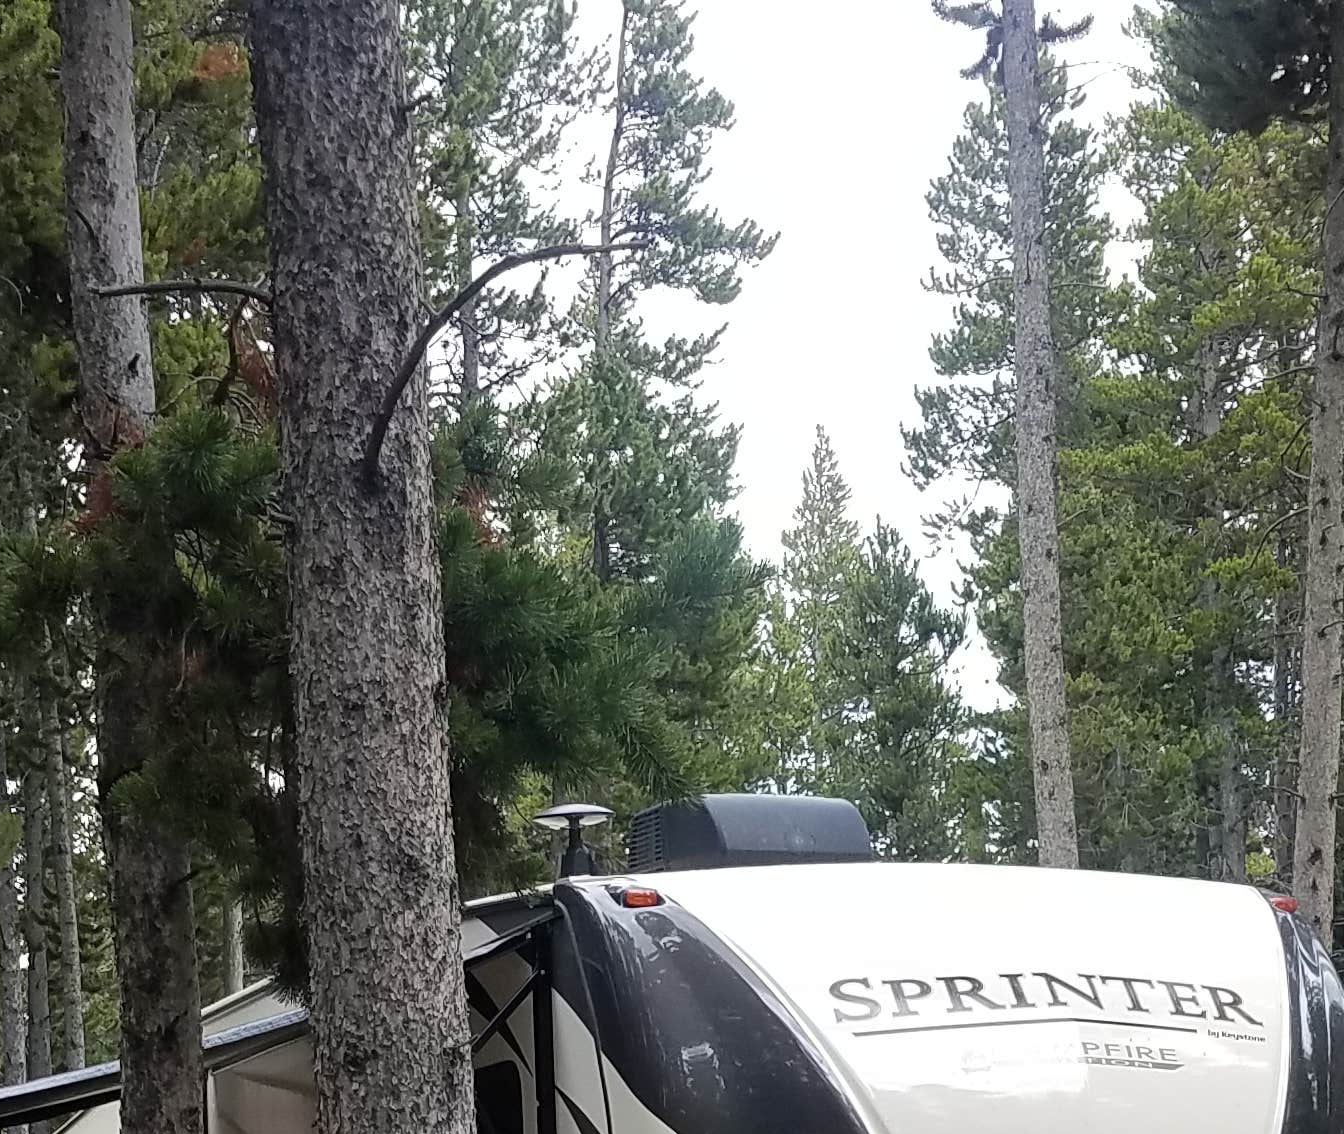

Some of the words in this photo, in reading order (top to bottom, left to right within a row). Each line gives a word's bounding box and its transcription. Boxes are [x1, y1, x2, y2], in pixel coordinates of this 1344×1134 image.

[829, 972, 1264, 1026] SPRINTER
[1207, 1029, 1219, 1039] by
[1221, 1031, 1266, 1042] Keystone
[1060, 1041, 1178, 1062] PFIRE
